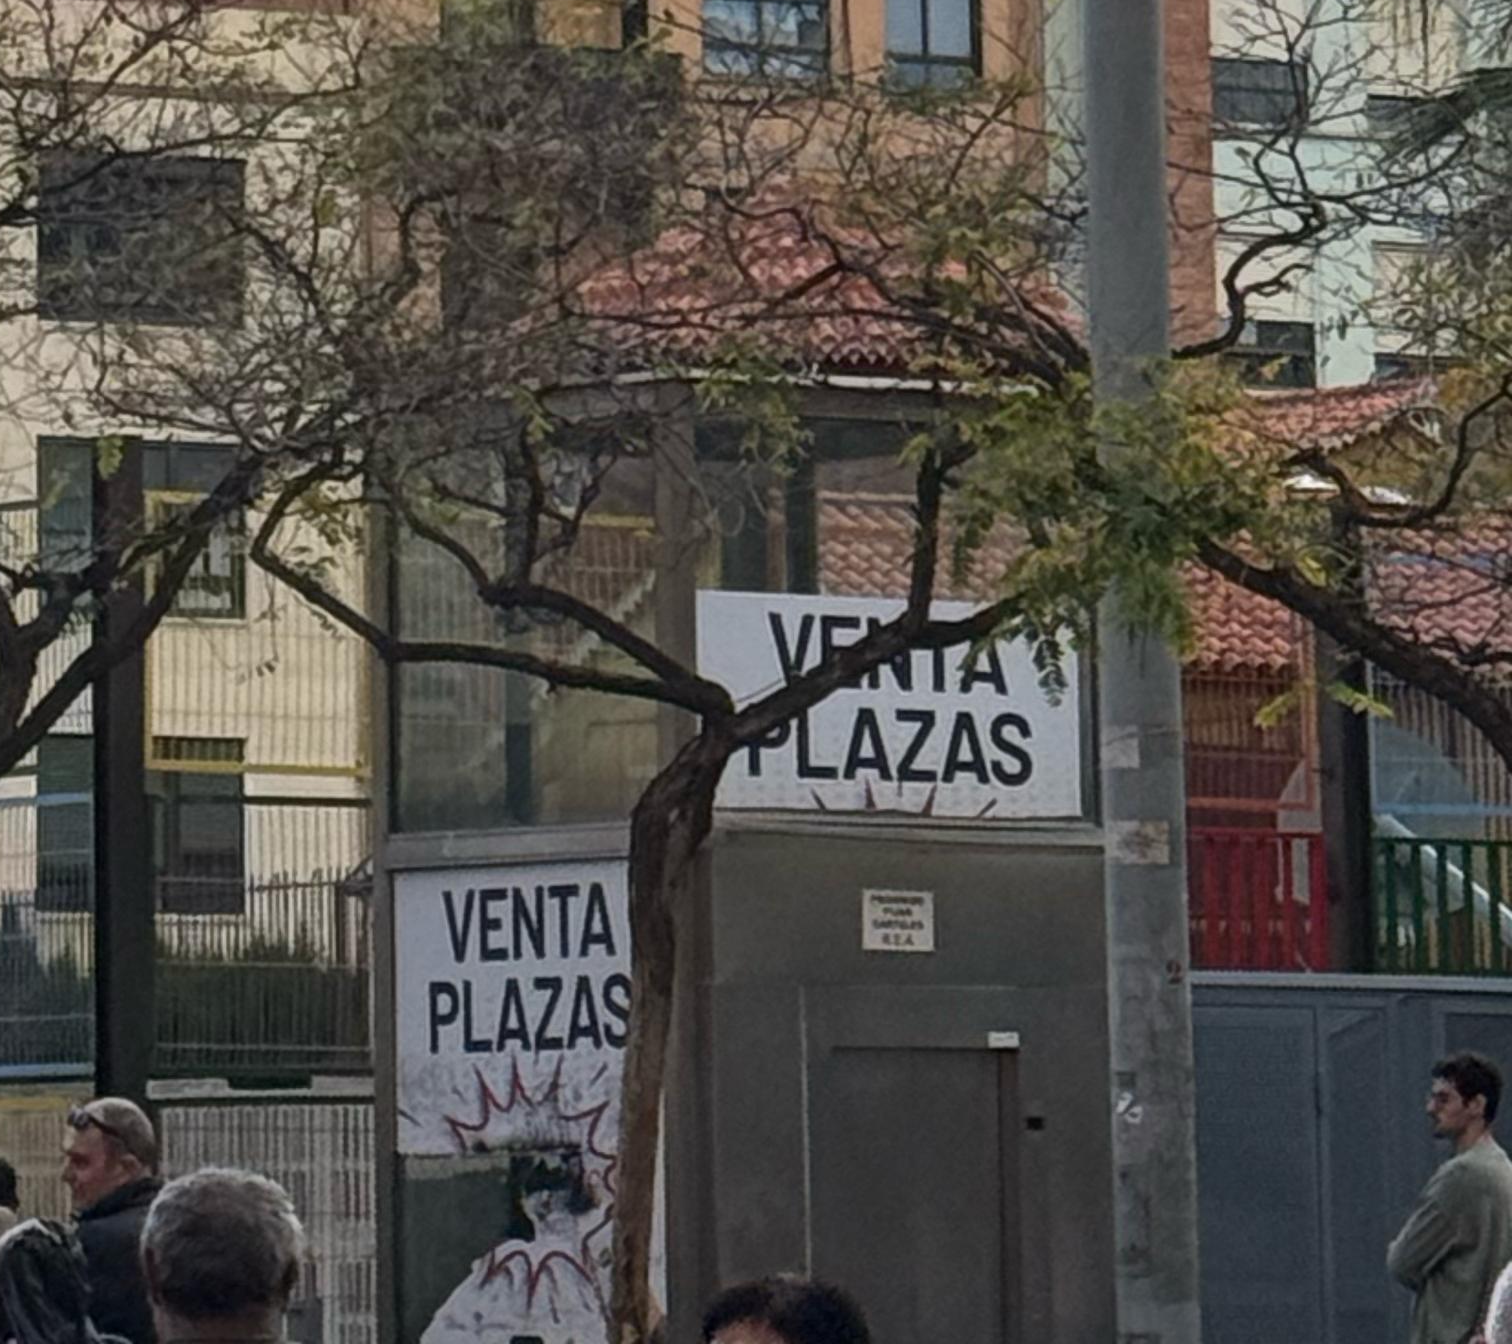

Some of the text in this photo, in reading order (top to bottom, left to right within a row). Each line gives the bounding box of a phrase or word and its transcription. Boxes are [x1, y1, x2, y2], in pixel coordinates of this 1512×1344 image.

[746, 706, 1034, 786] PLAZAS
[441, 881, 617, 964] VENTA
[428, 972, 633, 1055] PLAZAS
